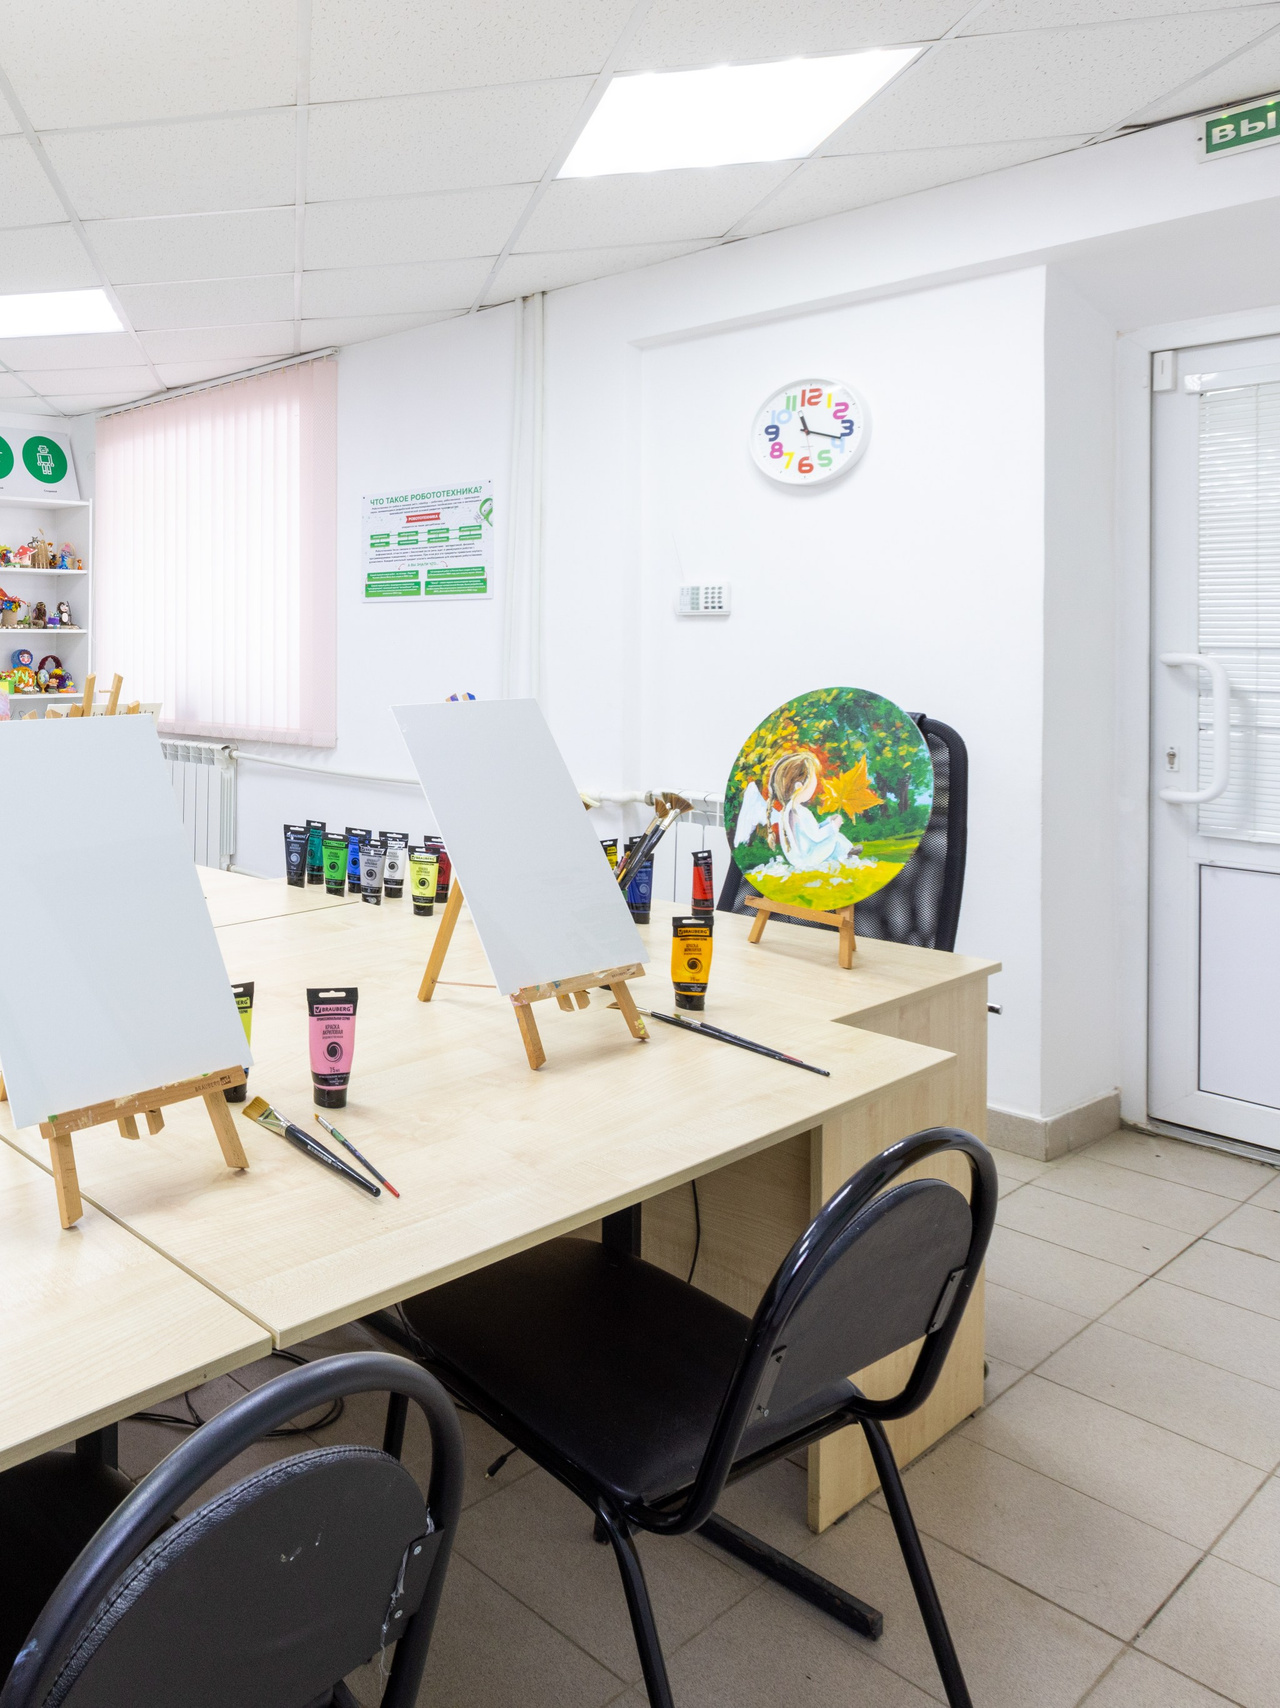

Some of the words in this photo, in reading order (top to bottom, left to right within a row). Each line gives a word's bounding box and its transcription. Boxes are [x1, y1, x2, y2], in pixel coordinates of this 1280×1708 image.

[785, 395, 797, 411] 11
[801, 388, 823, 407] 12
[826, 392, 832, 409] 1
[771, 409, 793, 425] 10
[832, 402, 849, 420] 2
[764, 424, 780, 442] 9
[840, 419, 855, 437] 3
[769, 441, 784, 459] 8
[817, 449, 833, 468] 5
[783, 451, 795, 470] 7
[797, 456, 814, 474] 6
[386, 494, 409, 504] ТАКОЕ
[410, 485, 482, 501] РОБОТОТЕХНИКА?
